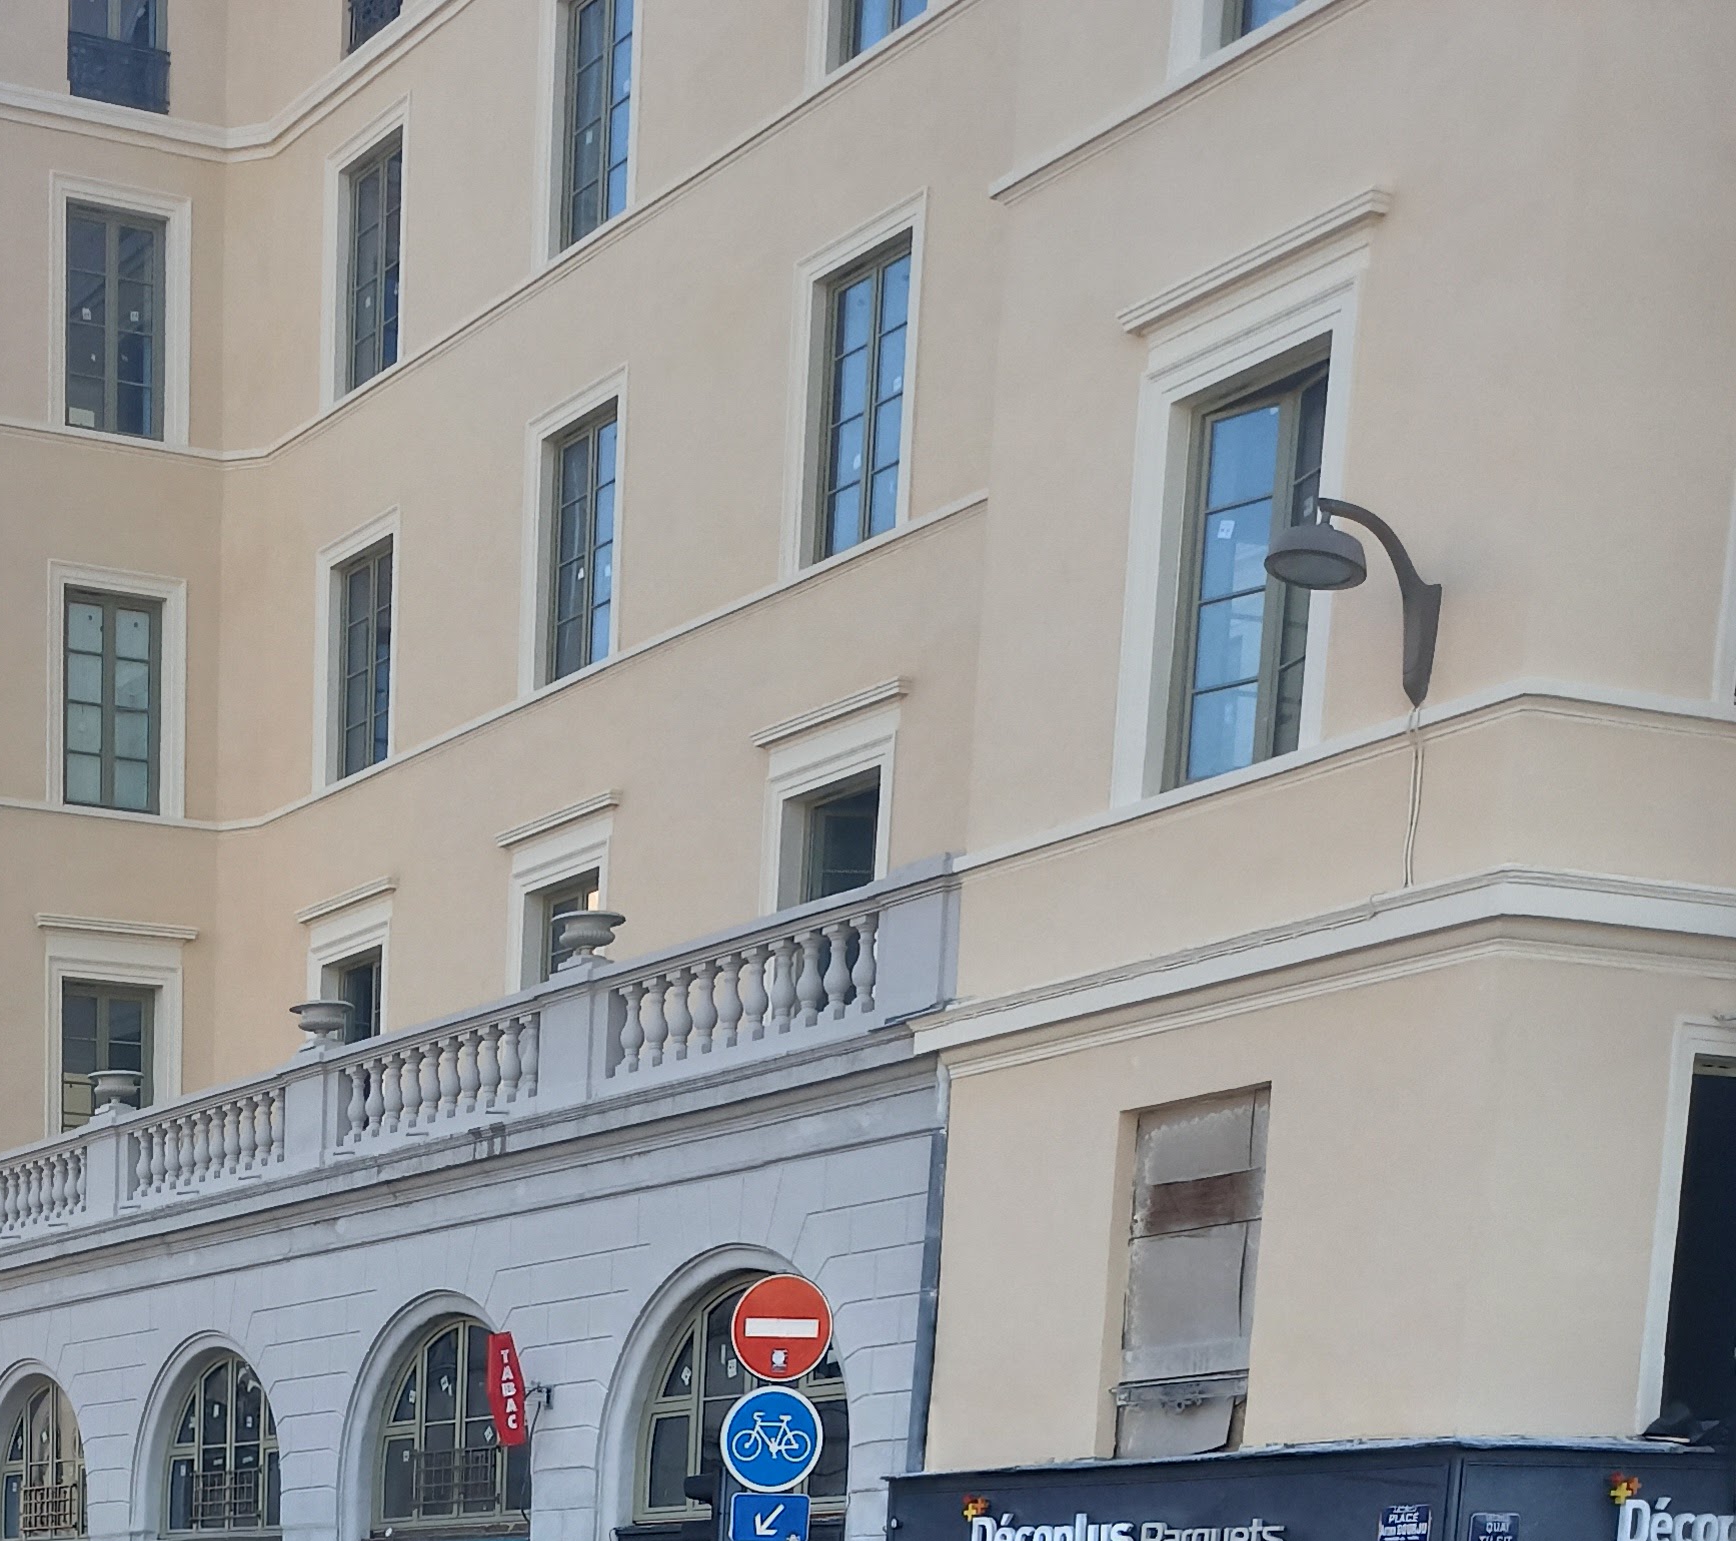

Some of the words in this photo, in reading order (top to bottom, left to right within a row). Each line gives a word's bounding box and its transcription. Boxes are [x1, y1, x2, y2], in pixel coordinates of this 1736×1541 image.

[500, 1349, 518, 1429] TABAC
[1388, 1512, 1419, 1524] PLACE
[1485, 1522, 1510, 1533] QUAI
